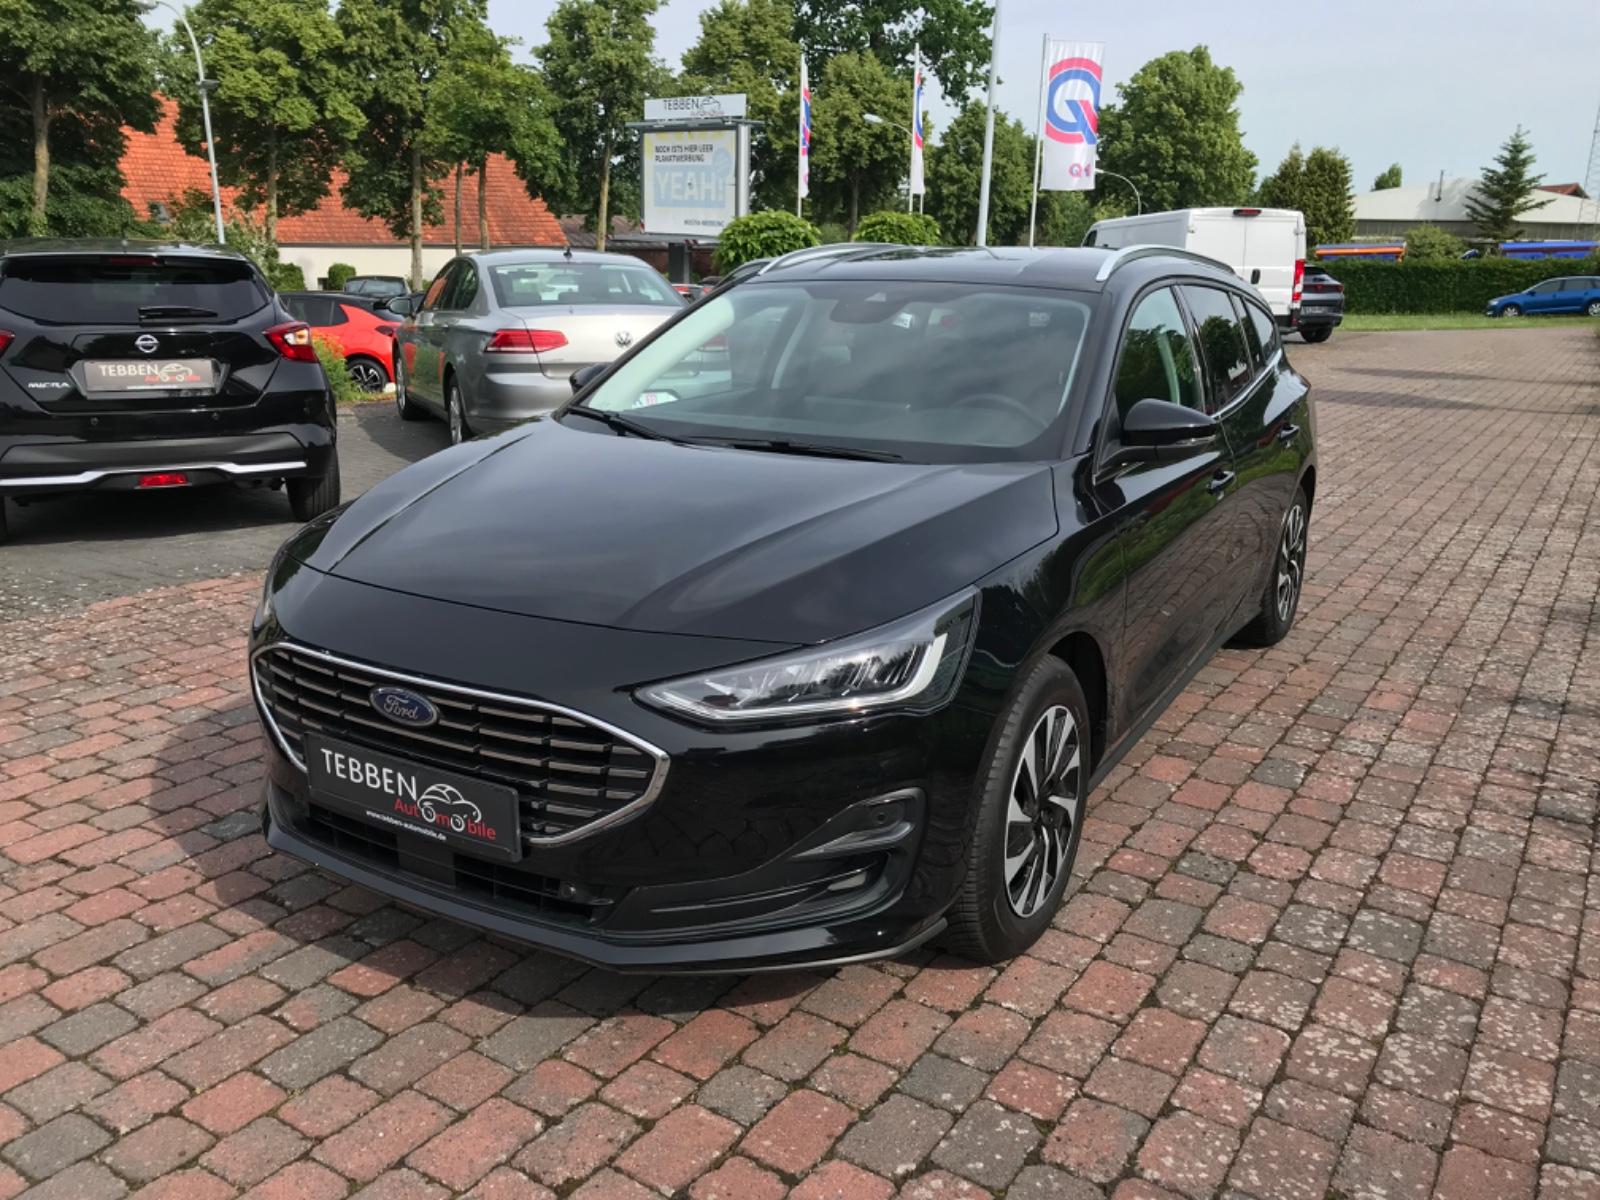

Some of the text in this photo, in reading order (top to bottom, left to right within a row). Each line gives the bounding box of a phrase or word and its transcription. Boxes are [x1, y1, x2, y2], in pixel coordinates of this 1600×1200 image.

[663, 98, 699, 111] TEBBEN
[99, 363, 159, 377] TEBBEN
[383, 694, 418, 720] Ford
[320, 748, 417, 801] TEBBEN
[394, 798, 497, 841] Automobile
